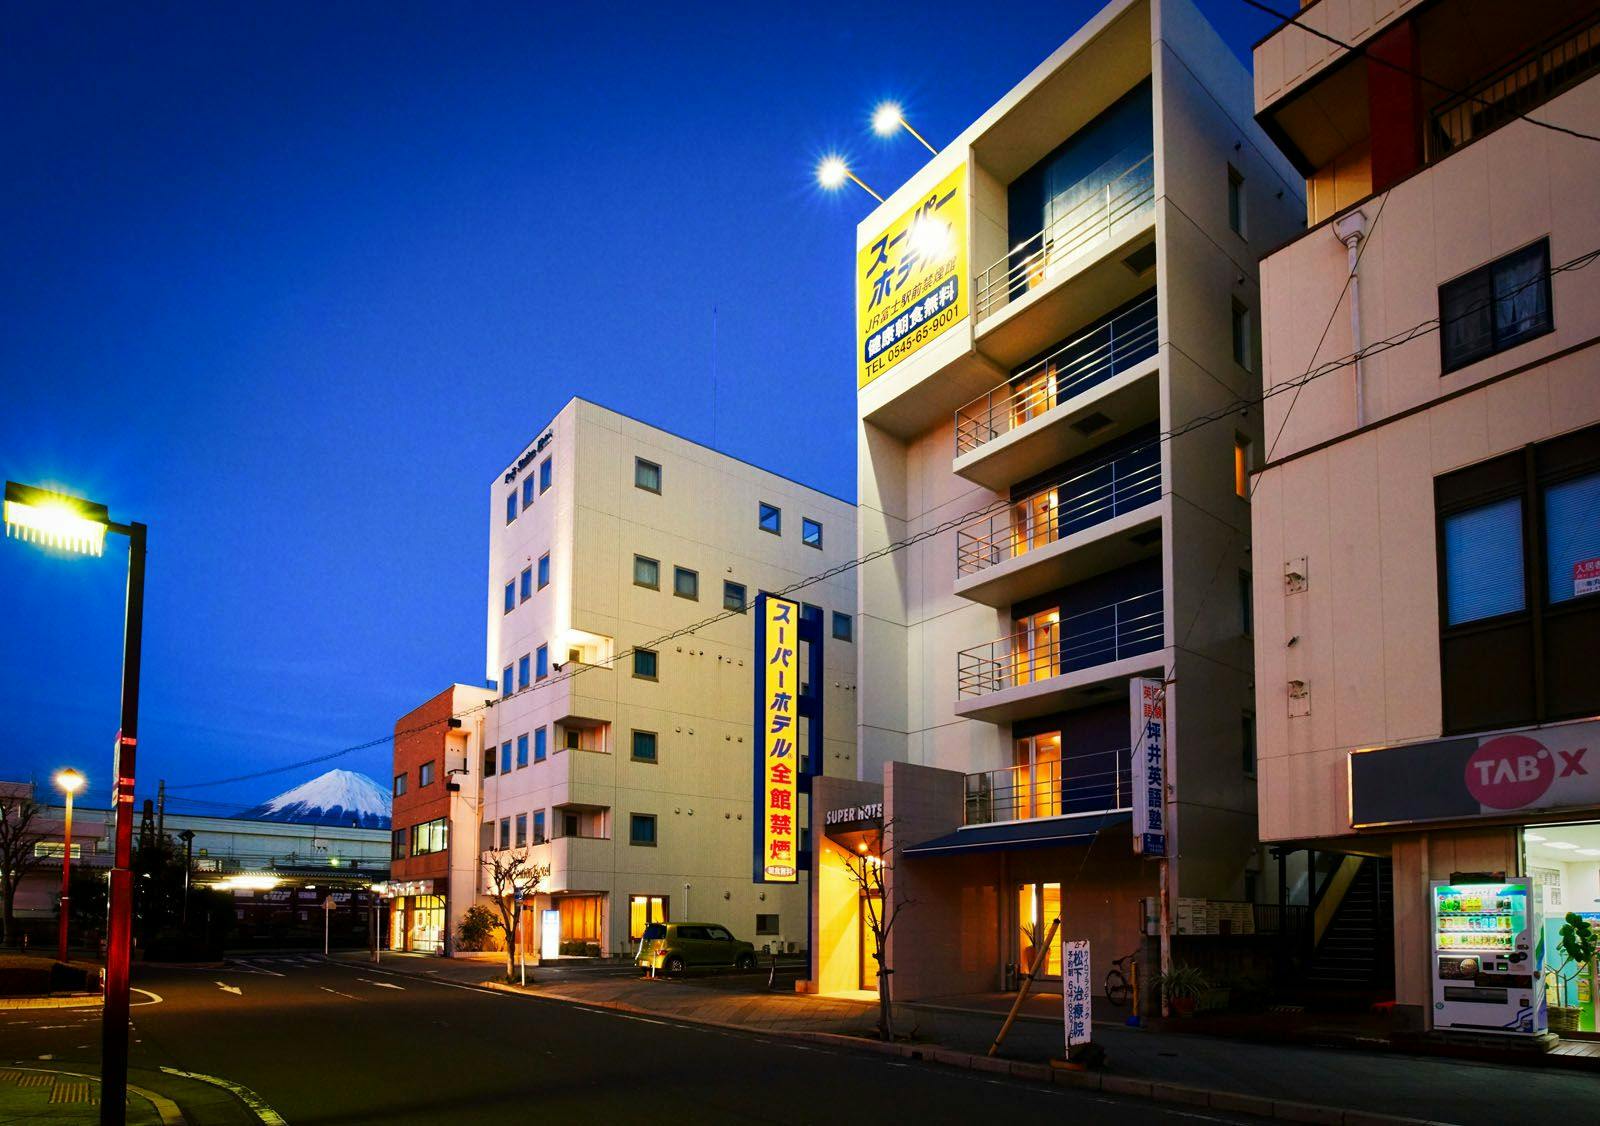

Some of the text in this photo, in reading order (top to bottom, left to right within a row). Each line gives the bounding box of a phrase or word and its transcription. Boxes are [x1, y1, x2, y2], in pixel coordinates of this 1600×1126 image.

[865, 304, 959, 378] TEL 0545-65-9001
[826, 807, 855, 825] SUPER
[1073, 950, 1084, 1037] 松下治療院
